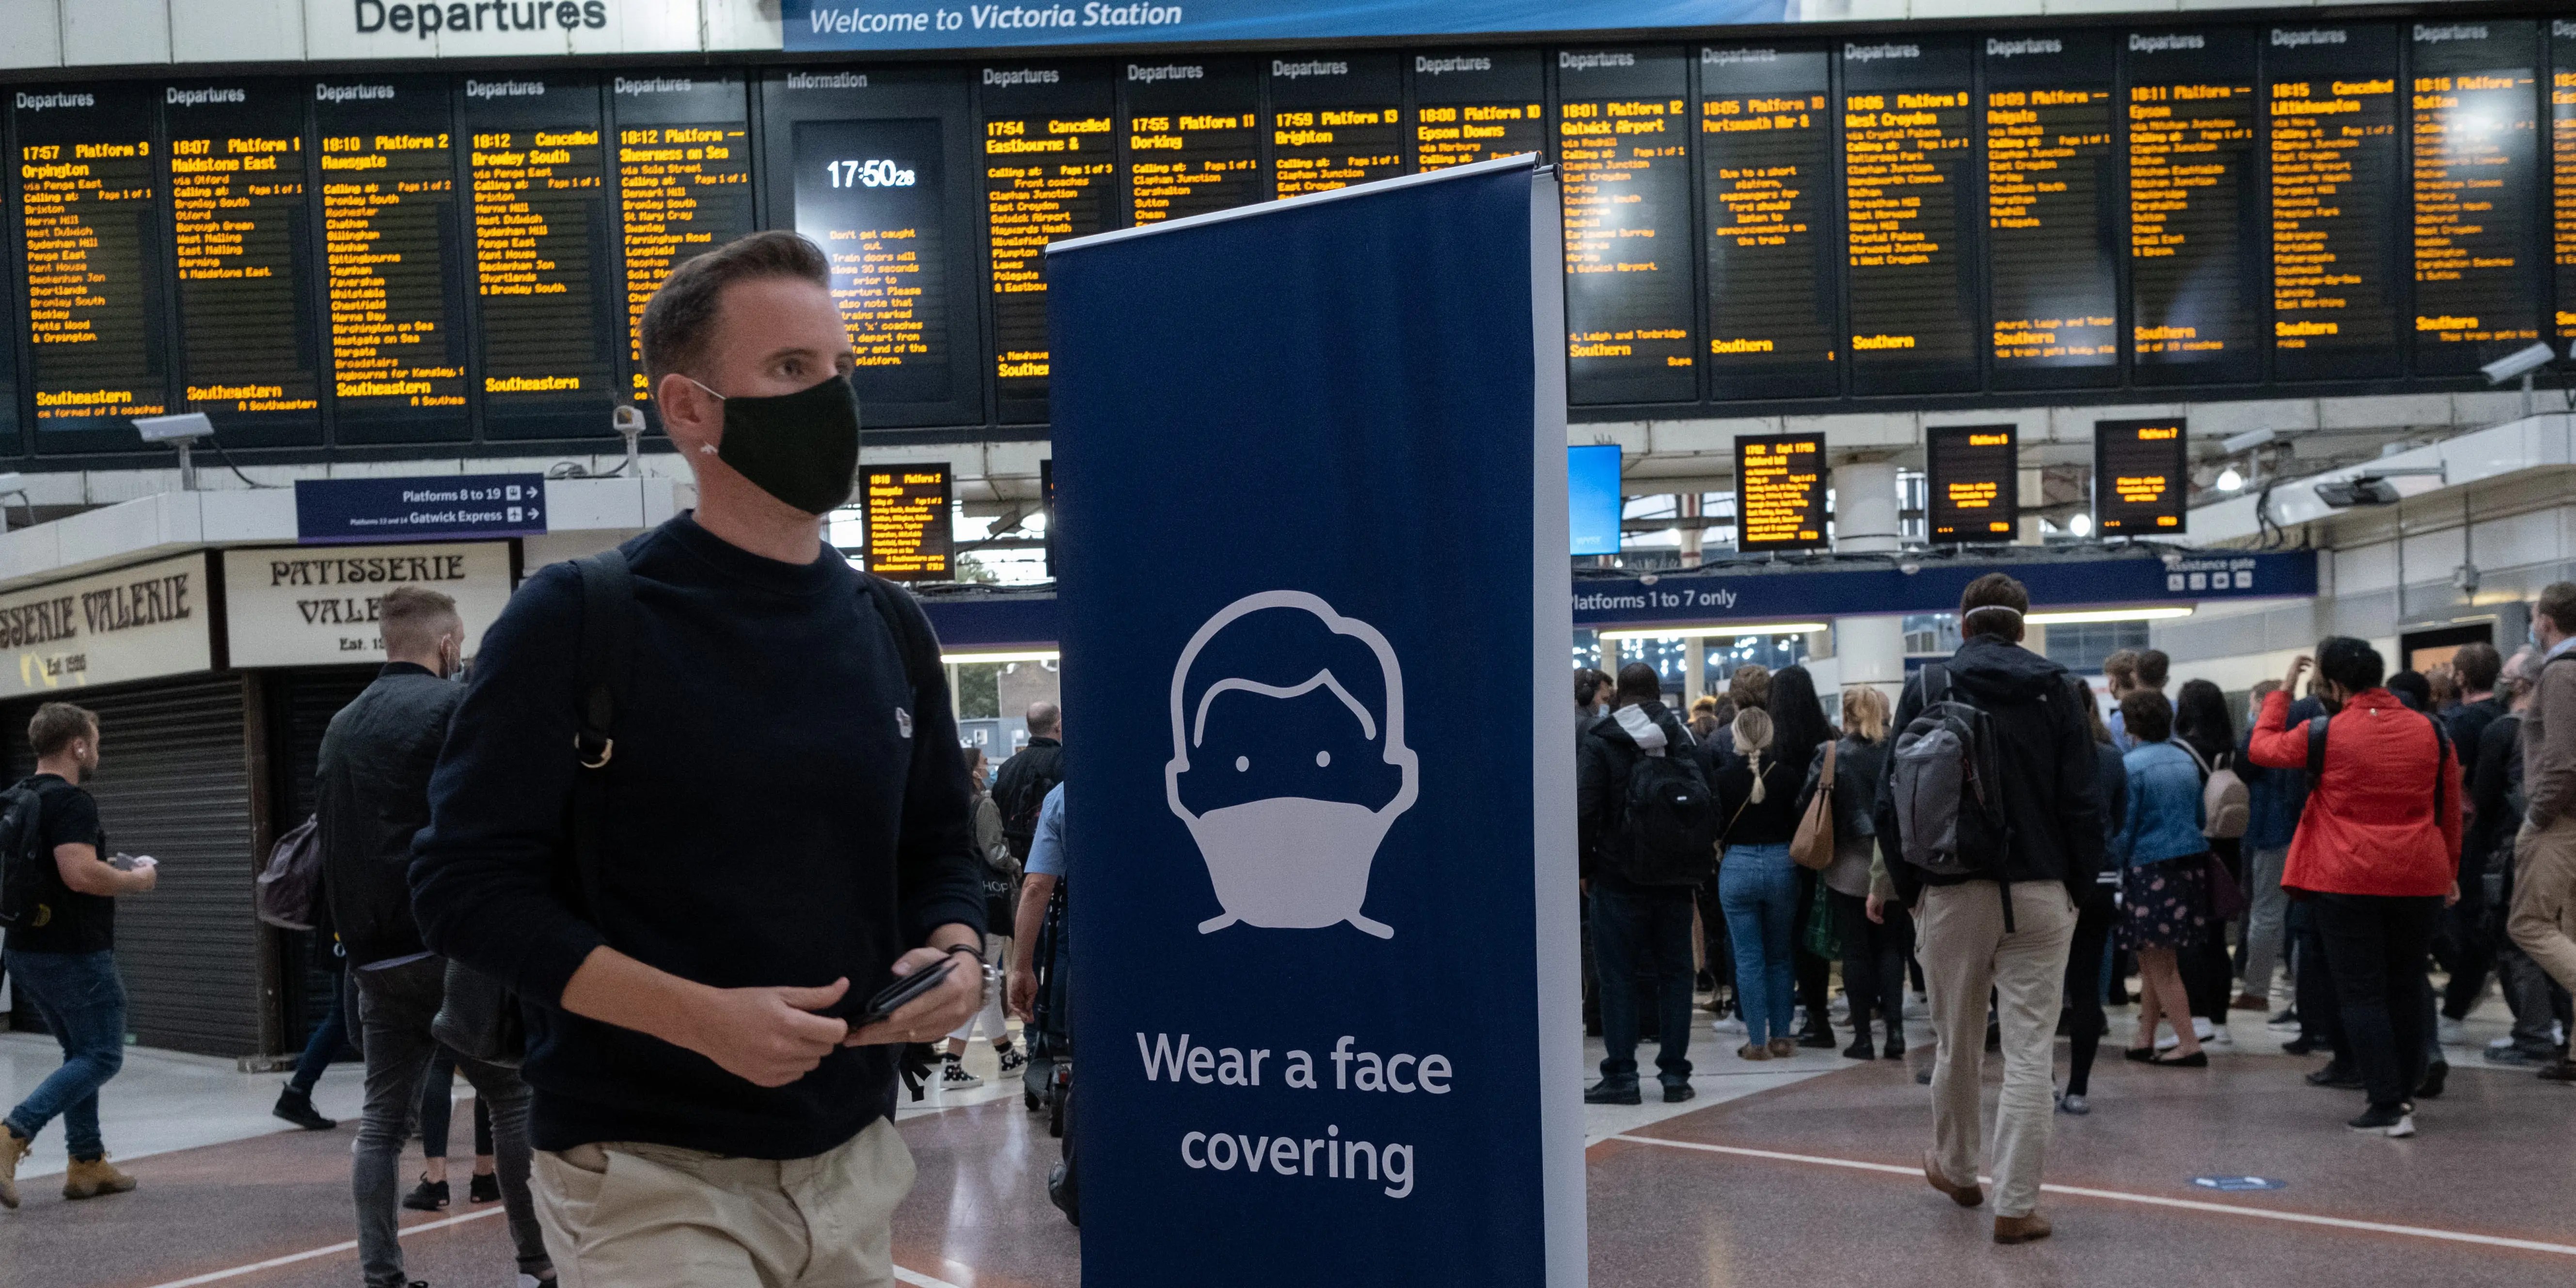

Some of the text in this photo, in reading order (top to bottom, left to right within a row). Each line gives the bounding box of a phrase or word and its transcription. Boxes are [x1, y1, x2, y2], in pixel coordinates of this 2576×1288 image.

[355, 0, 606, 40] Departures
[812, 2, 1182, 33] Welcome to Victoria Station
[2272, 30, 2346, 48] Departures
[2414, 25, 2488, 43] Departures
[1987, 39, 2062, 57] Departures
[2129, 34, 2204, 53] Departures
[1560, 52, 1635, 71] Departures
[1702, 49, 1777, 66] Departures
[1844, 44, 1920, 63] Departures
[1128, 64, 1203, 83] Departures
[1273, 61, 1347, 79] Departures
[1416, 57, 1491, 75] Departures
[615, 77, 692, 95] Departures
[787, 72, 868, 91] Information
[983, 69, 1059, 88] Departures
[167, 88, 245, 106] Departures
[316, 84, 395, 103] Departures
[467, 80, 545, 99] Departures
[17, 92, 94, 111] Departures
[1563, 100, 1683, 118] 18:01 Platform 12
[1277, 110, 1398, 127] 17:59 Platform 13
[1420, 105, 1540, 122] 18:00 Platform 10
[1846, 111, 1936, 127] West Croydon
[988, 118, 1110, 135] 17:54 Cancelled
[1133, 114, 1254, 131] 17:55 Platform 11
[1561, 119, 1664, 135] Gatwick Airport
[474, 131, 598, 148] 18:12 Cancelled
[621, 129, 723, 144] 18:12 Platform
[1275, 130, 1333, 145] Brighton
[1418, 125, 1504, 141] Epsom Downs
[174, 137, 300, 155] 18:07 Platform 1
[324, 134, 448, 151] 18:10 Platform 2
[986, 137, 1079, 153] Eastbourne &
[1131, 135, 1182, 149] Dorking
[24, 142, 148, 160] 17:57 Platform 3
[473, 150, 569, 166] Bromley South
[620, 146, 728, 162] Sheerness on Sea
[22, 163, 89, 179] Orpington
[172, 156, 276, 172] Maidstone East
[1712, 339, 1773, 353] Southern
[1853, 335, 1914, 350] Southern
[1994, 332, 2054, 345] Southern
[1571, 344, 1631, 356] Southern
[188, 385, 282, 400] Southeastern
[337, 381, 431, 396] Southeastern
[486, 377, 579, 392] Southeastern
[37, 390, 131, 405] Southeastern
[403, 488, 501, 503] Platforms 8 to 19
[410, 510, 502, 524] Gatwick Express
[270, 555, 465, 586] PATISSERIE
[81, 573, 191, 635] VALERIE
[1572, 589, 1737, 609] latforms 1 to 7 only
[297, 598, 381, 624] VALE
[1137, 1033, 1452, 1094] Wear a face
[1182, 1125, 1413, 1198] covering
